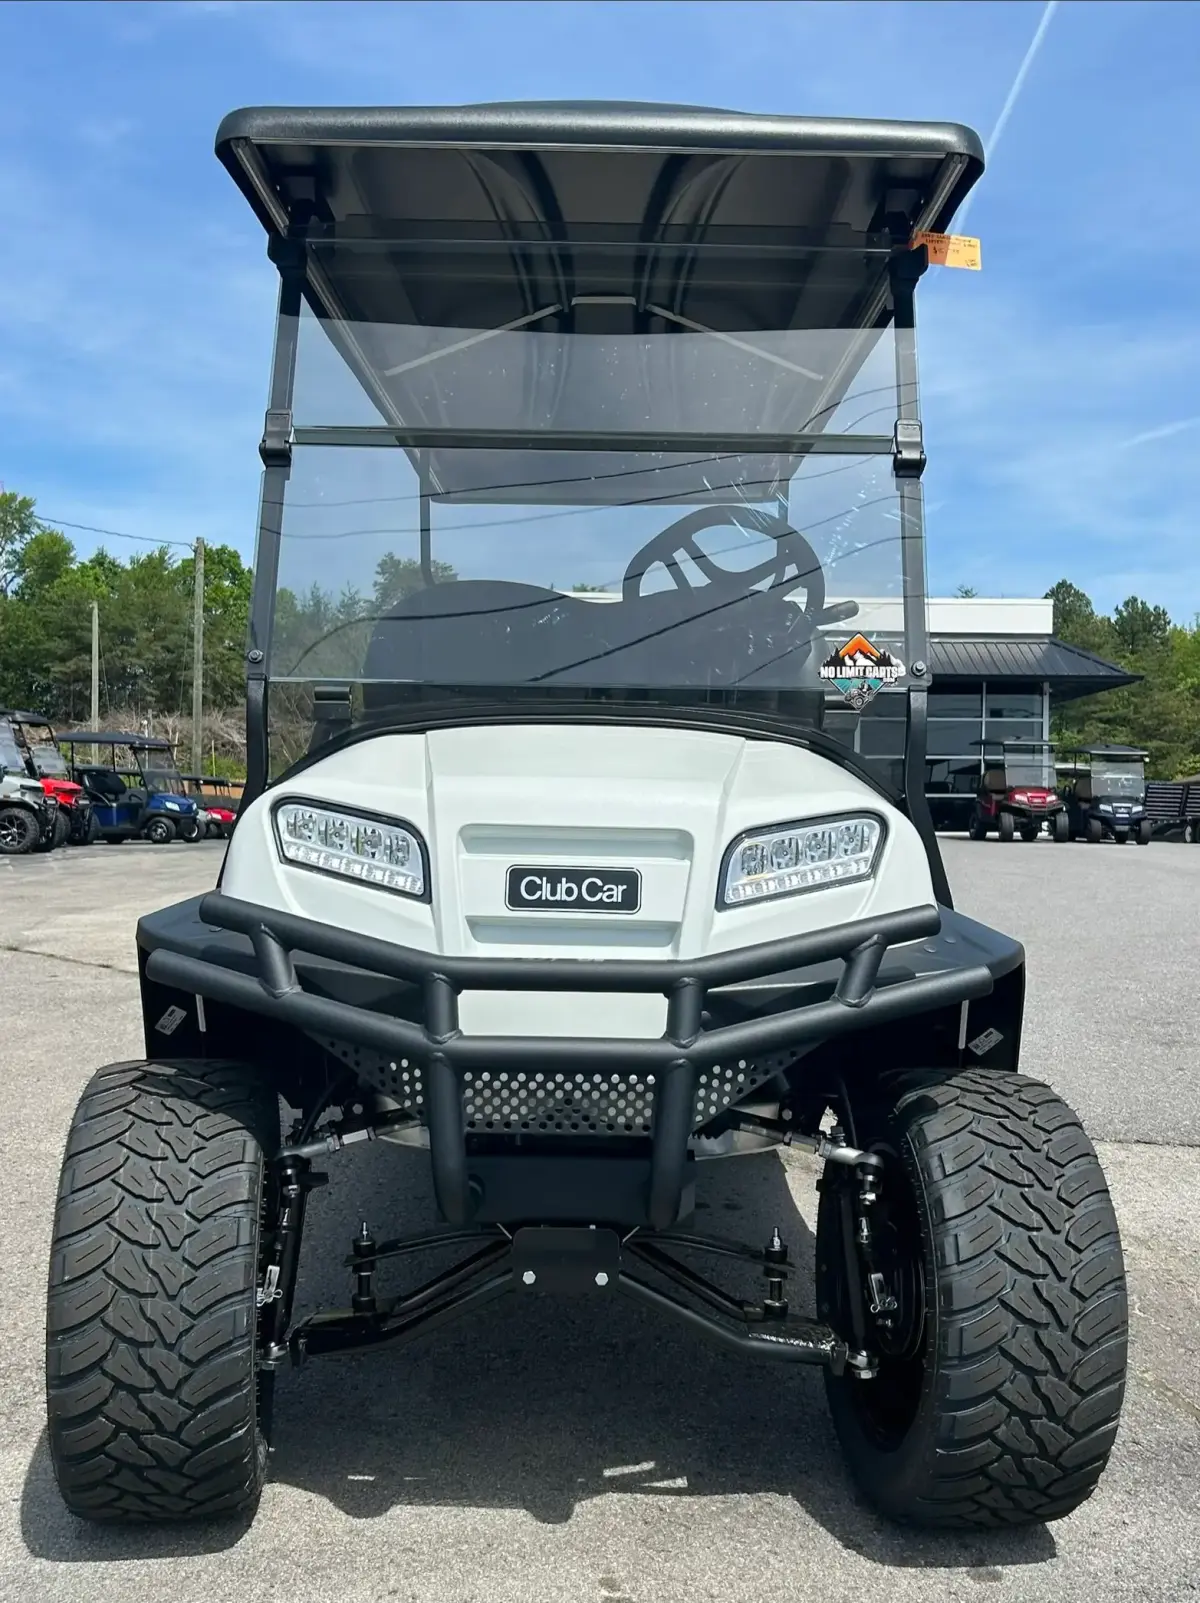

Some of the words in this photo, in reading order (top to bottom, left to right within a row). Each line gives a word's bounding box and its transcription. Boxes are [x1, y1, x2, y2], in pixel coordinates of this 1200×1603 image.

[820, 666, 835, 678] NO
[836, 666, 864, 678] LIMIT
[865, 666, 898, 678] CARTS
[520, 875, 579, 902] Club
[581, 877, 628, 903] Car
